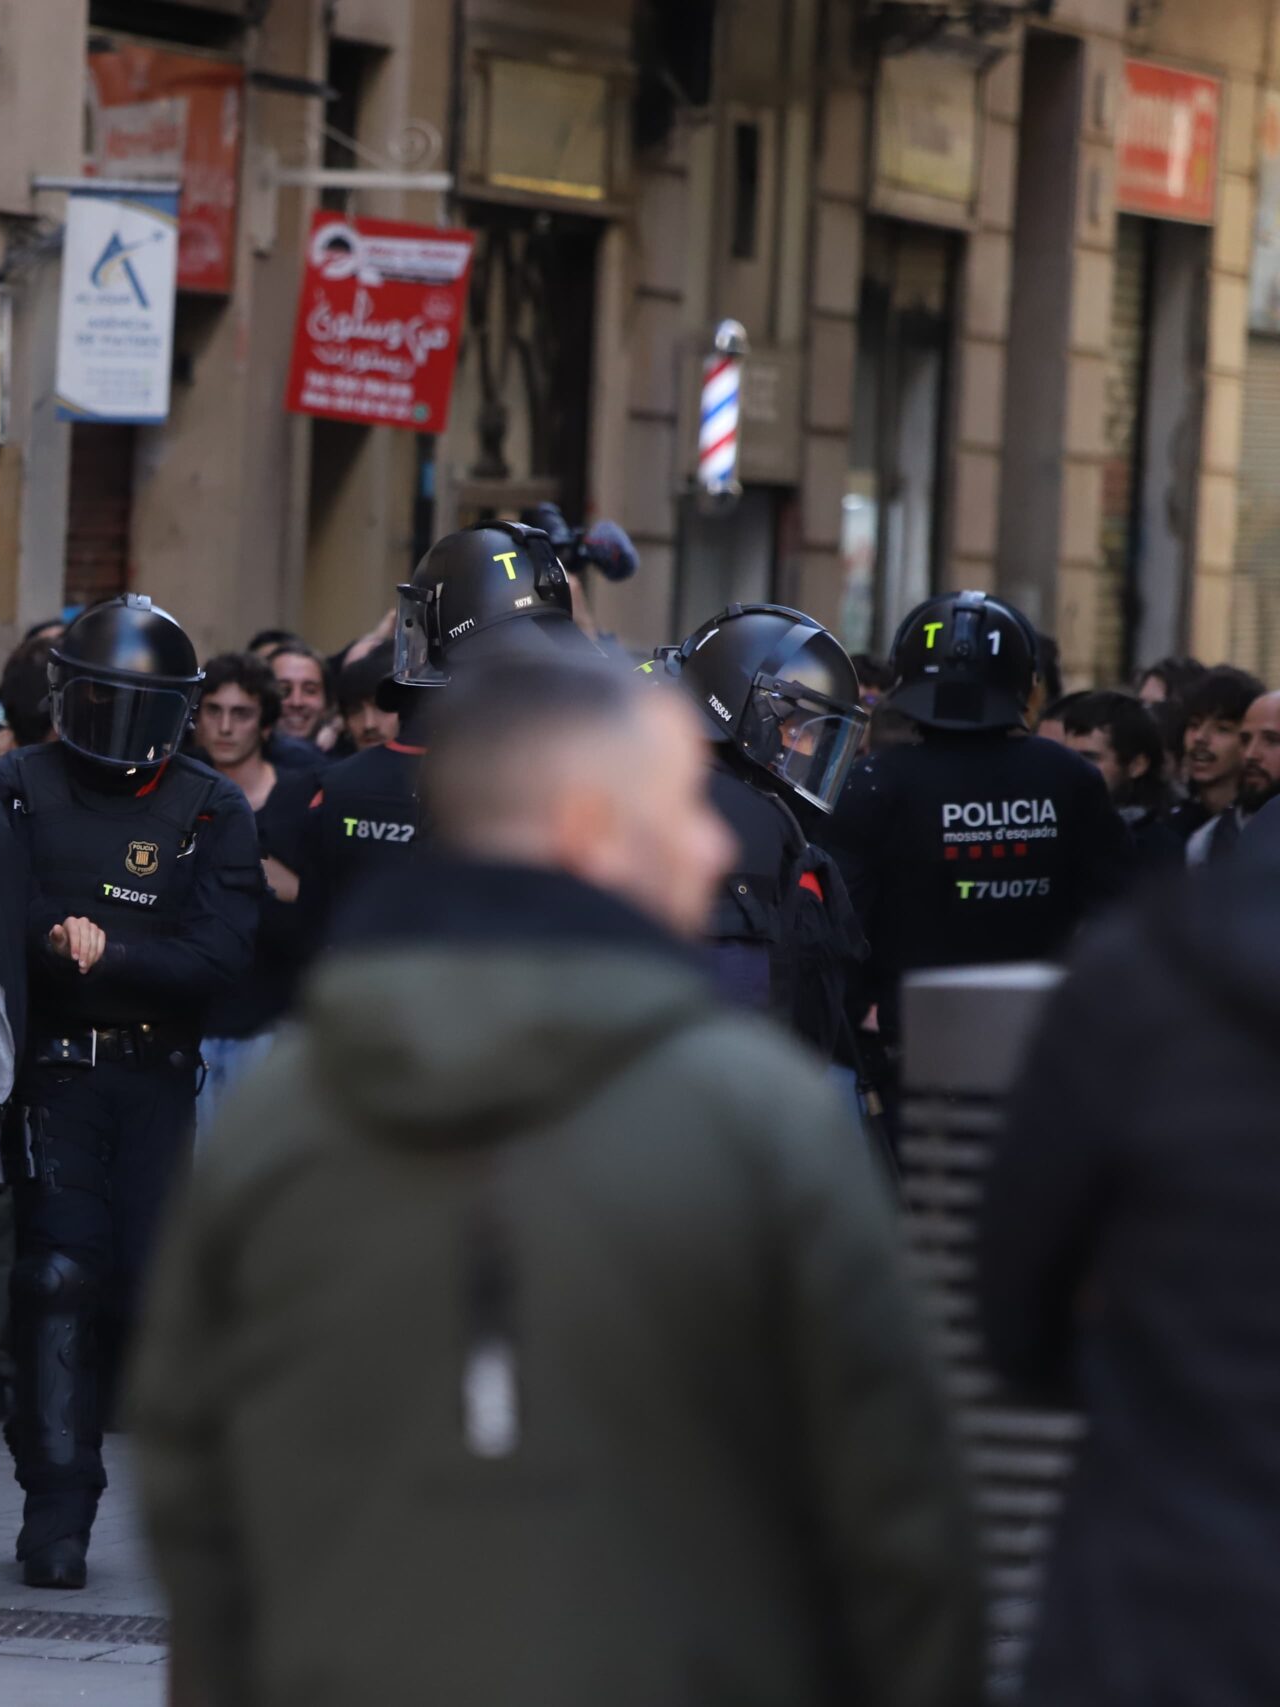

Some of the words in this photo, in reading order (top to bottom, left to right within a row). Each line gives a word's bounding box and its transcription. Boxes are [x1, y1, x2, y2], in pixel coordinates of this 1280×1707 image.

[493, 552, 518, 580] T
[923, 622, 943, 648] T
[987, 630, 1001, 655] 1
[942, 798, 1058, 828] POLICIA
[943, 830, 993, 842] mossos
[994, 825, 1058, 841] d'esquadra
[103, 883, 158, 906] T9Z067
[955, 877, 1051, 899] T7U075
